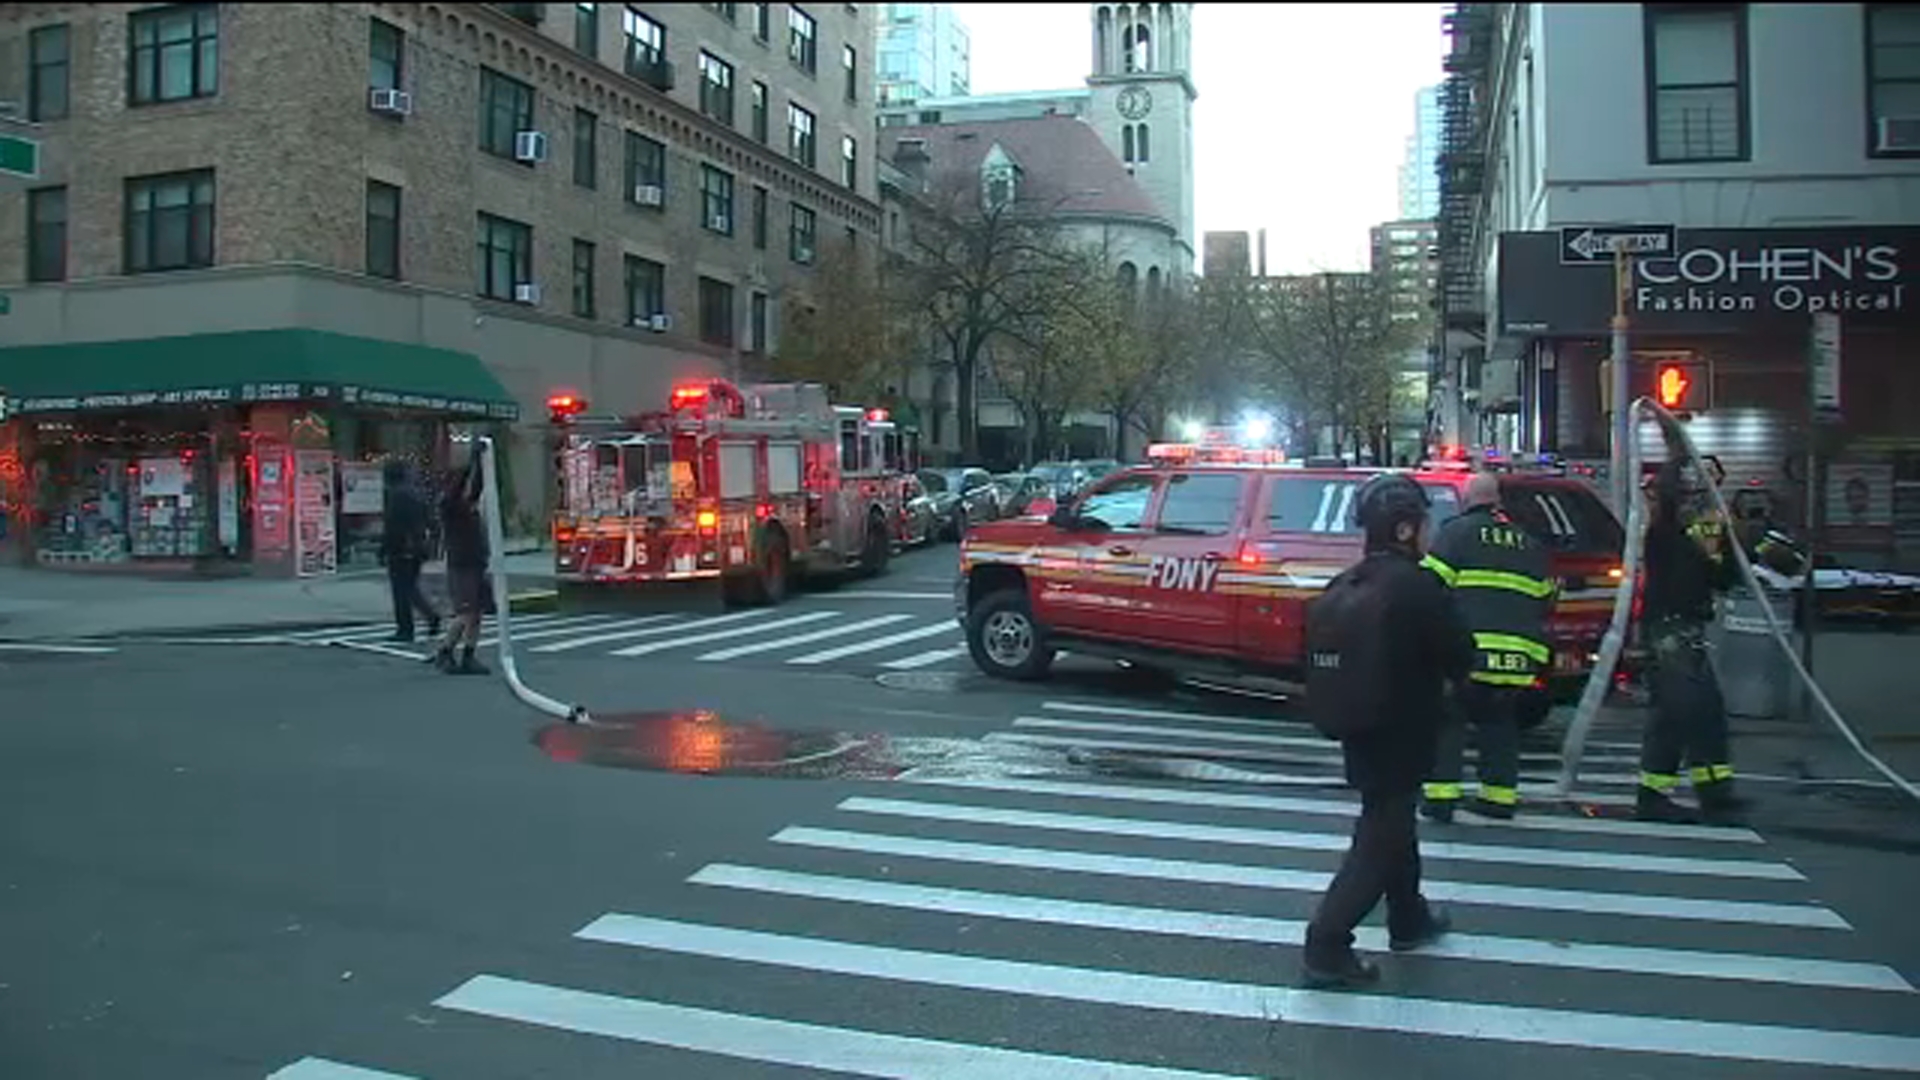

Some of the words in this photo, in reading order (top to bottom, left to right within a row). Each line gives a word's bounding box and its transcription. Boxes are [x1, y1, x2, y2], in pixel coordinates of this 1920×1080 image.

[1638, 246, 1898, 283] COHEN'S
[1637, 287, 1755, 311] Fashion
[1774, 284, 1901, 313] Optical
[1310, 483, 1356, 531] 11
[1145, 556, 1218, 592] FDNY
